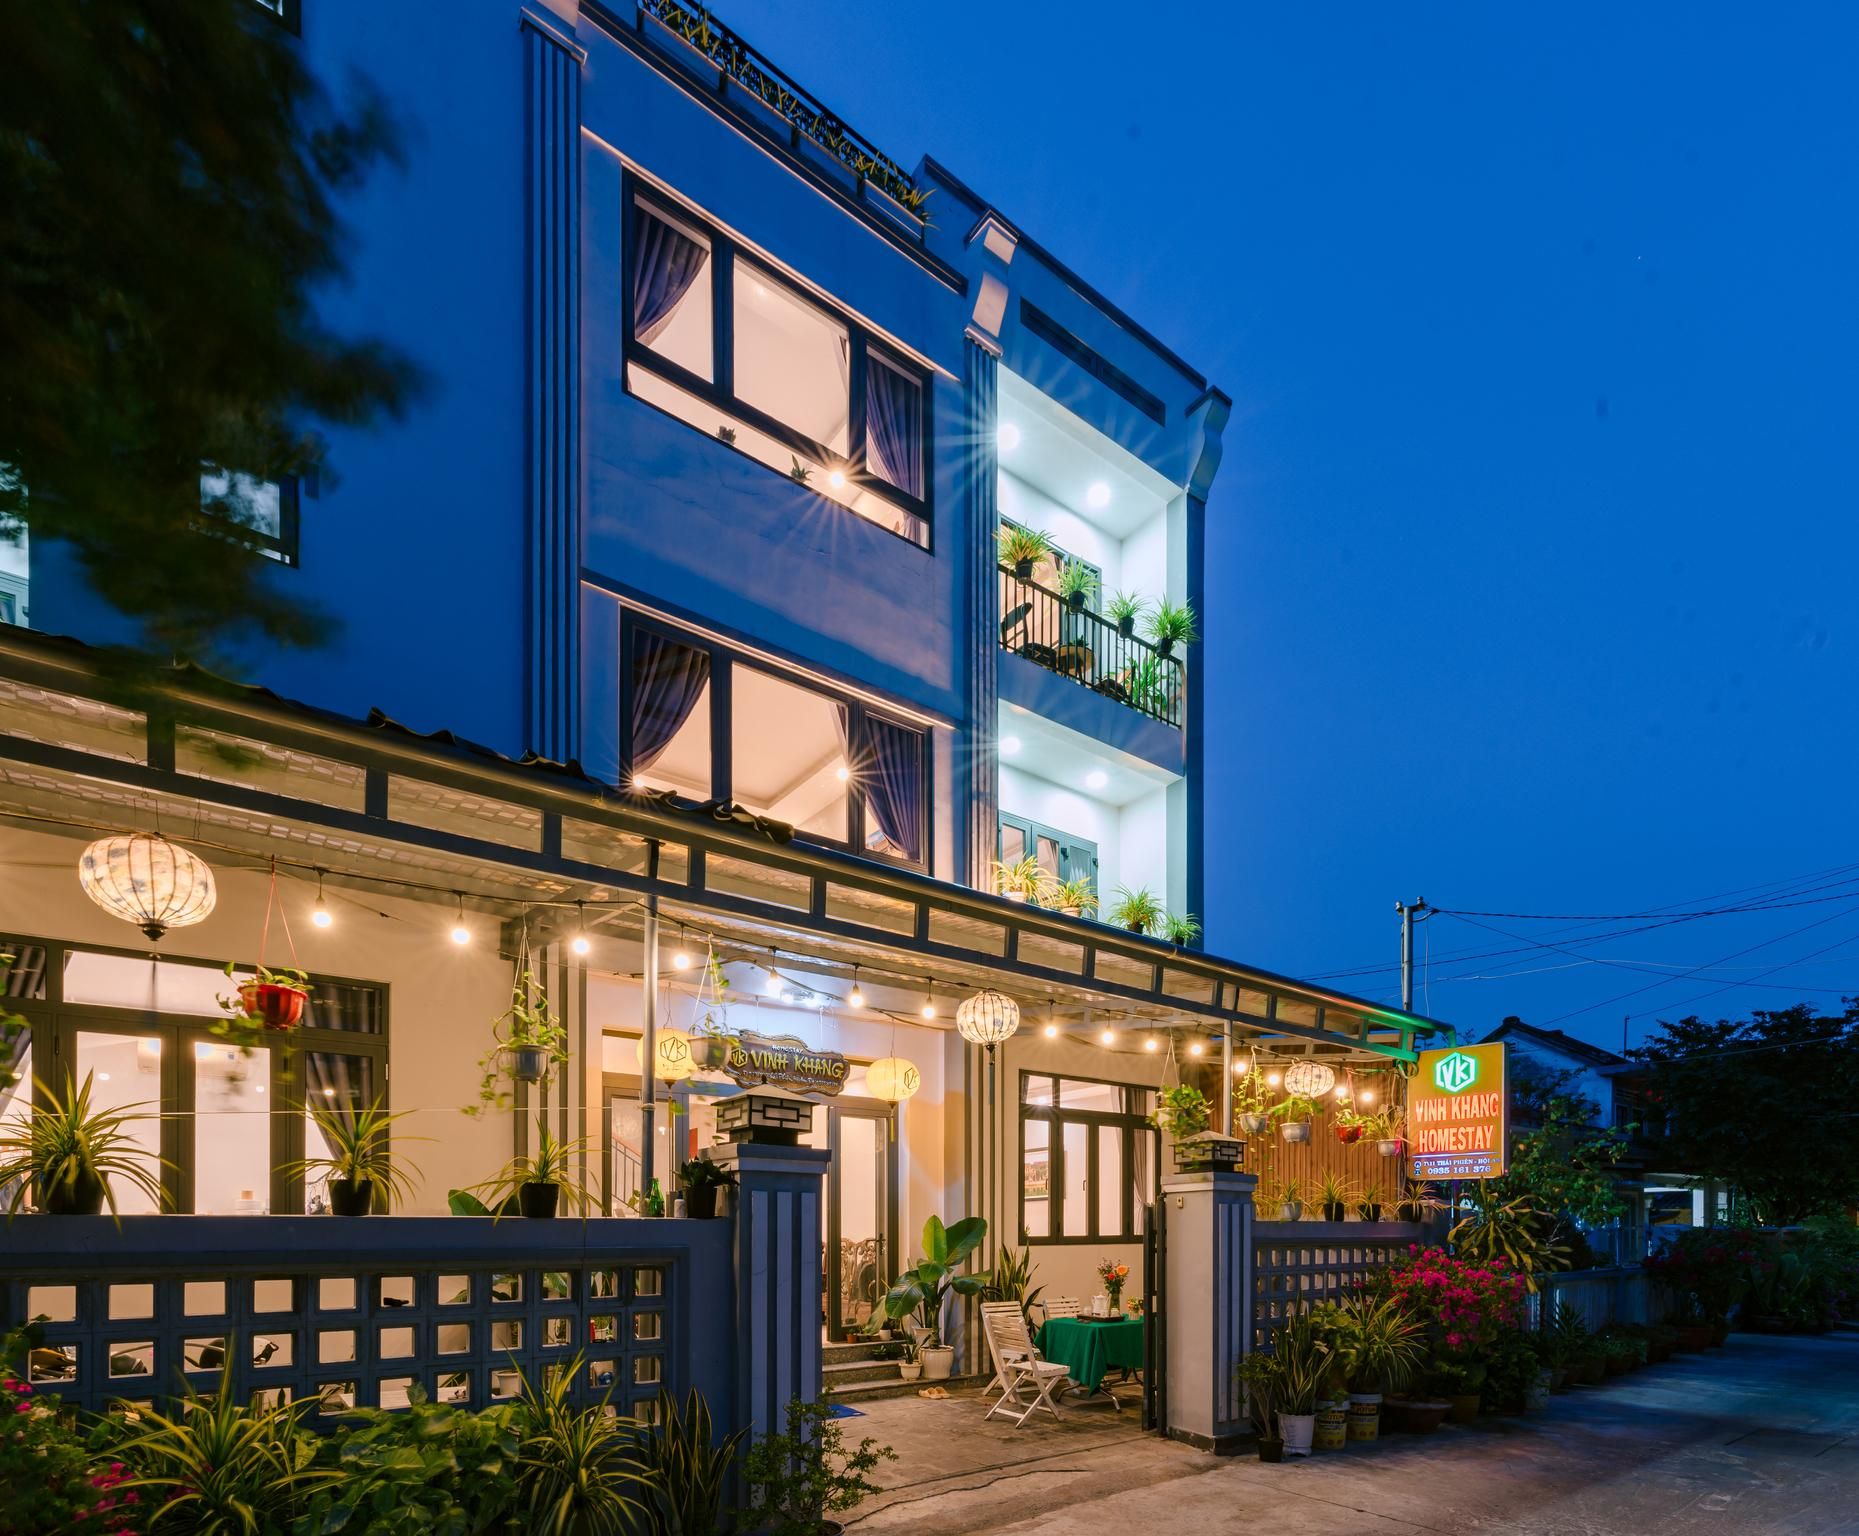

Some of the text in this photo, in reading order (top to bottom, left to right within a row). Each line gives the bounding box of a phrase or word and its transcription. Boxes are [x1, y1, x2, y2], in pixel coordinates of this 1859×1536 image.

[751, 1050, 788, 1071] VINH
[794, 1055, 844, 1078] KHANG
[1440, 1055, 1471, 1090] VK
[1415, 1093, 1499, 1122] VINH KHANG
[1420, 1125, 1493, 1152] HOMESTAY
